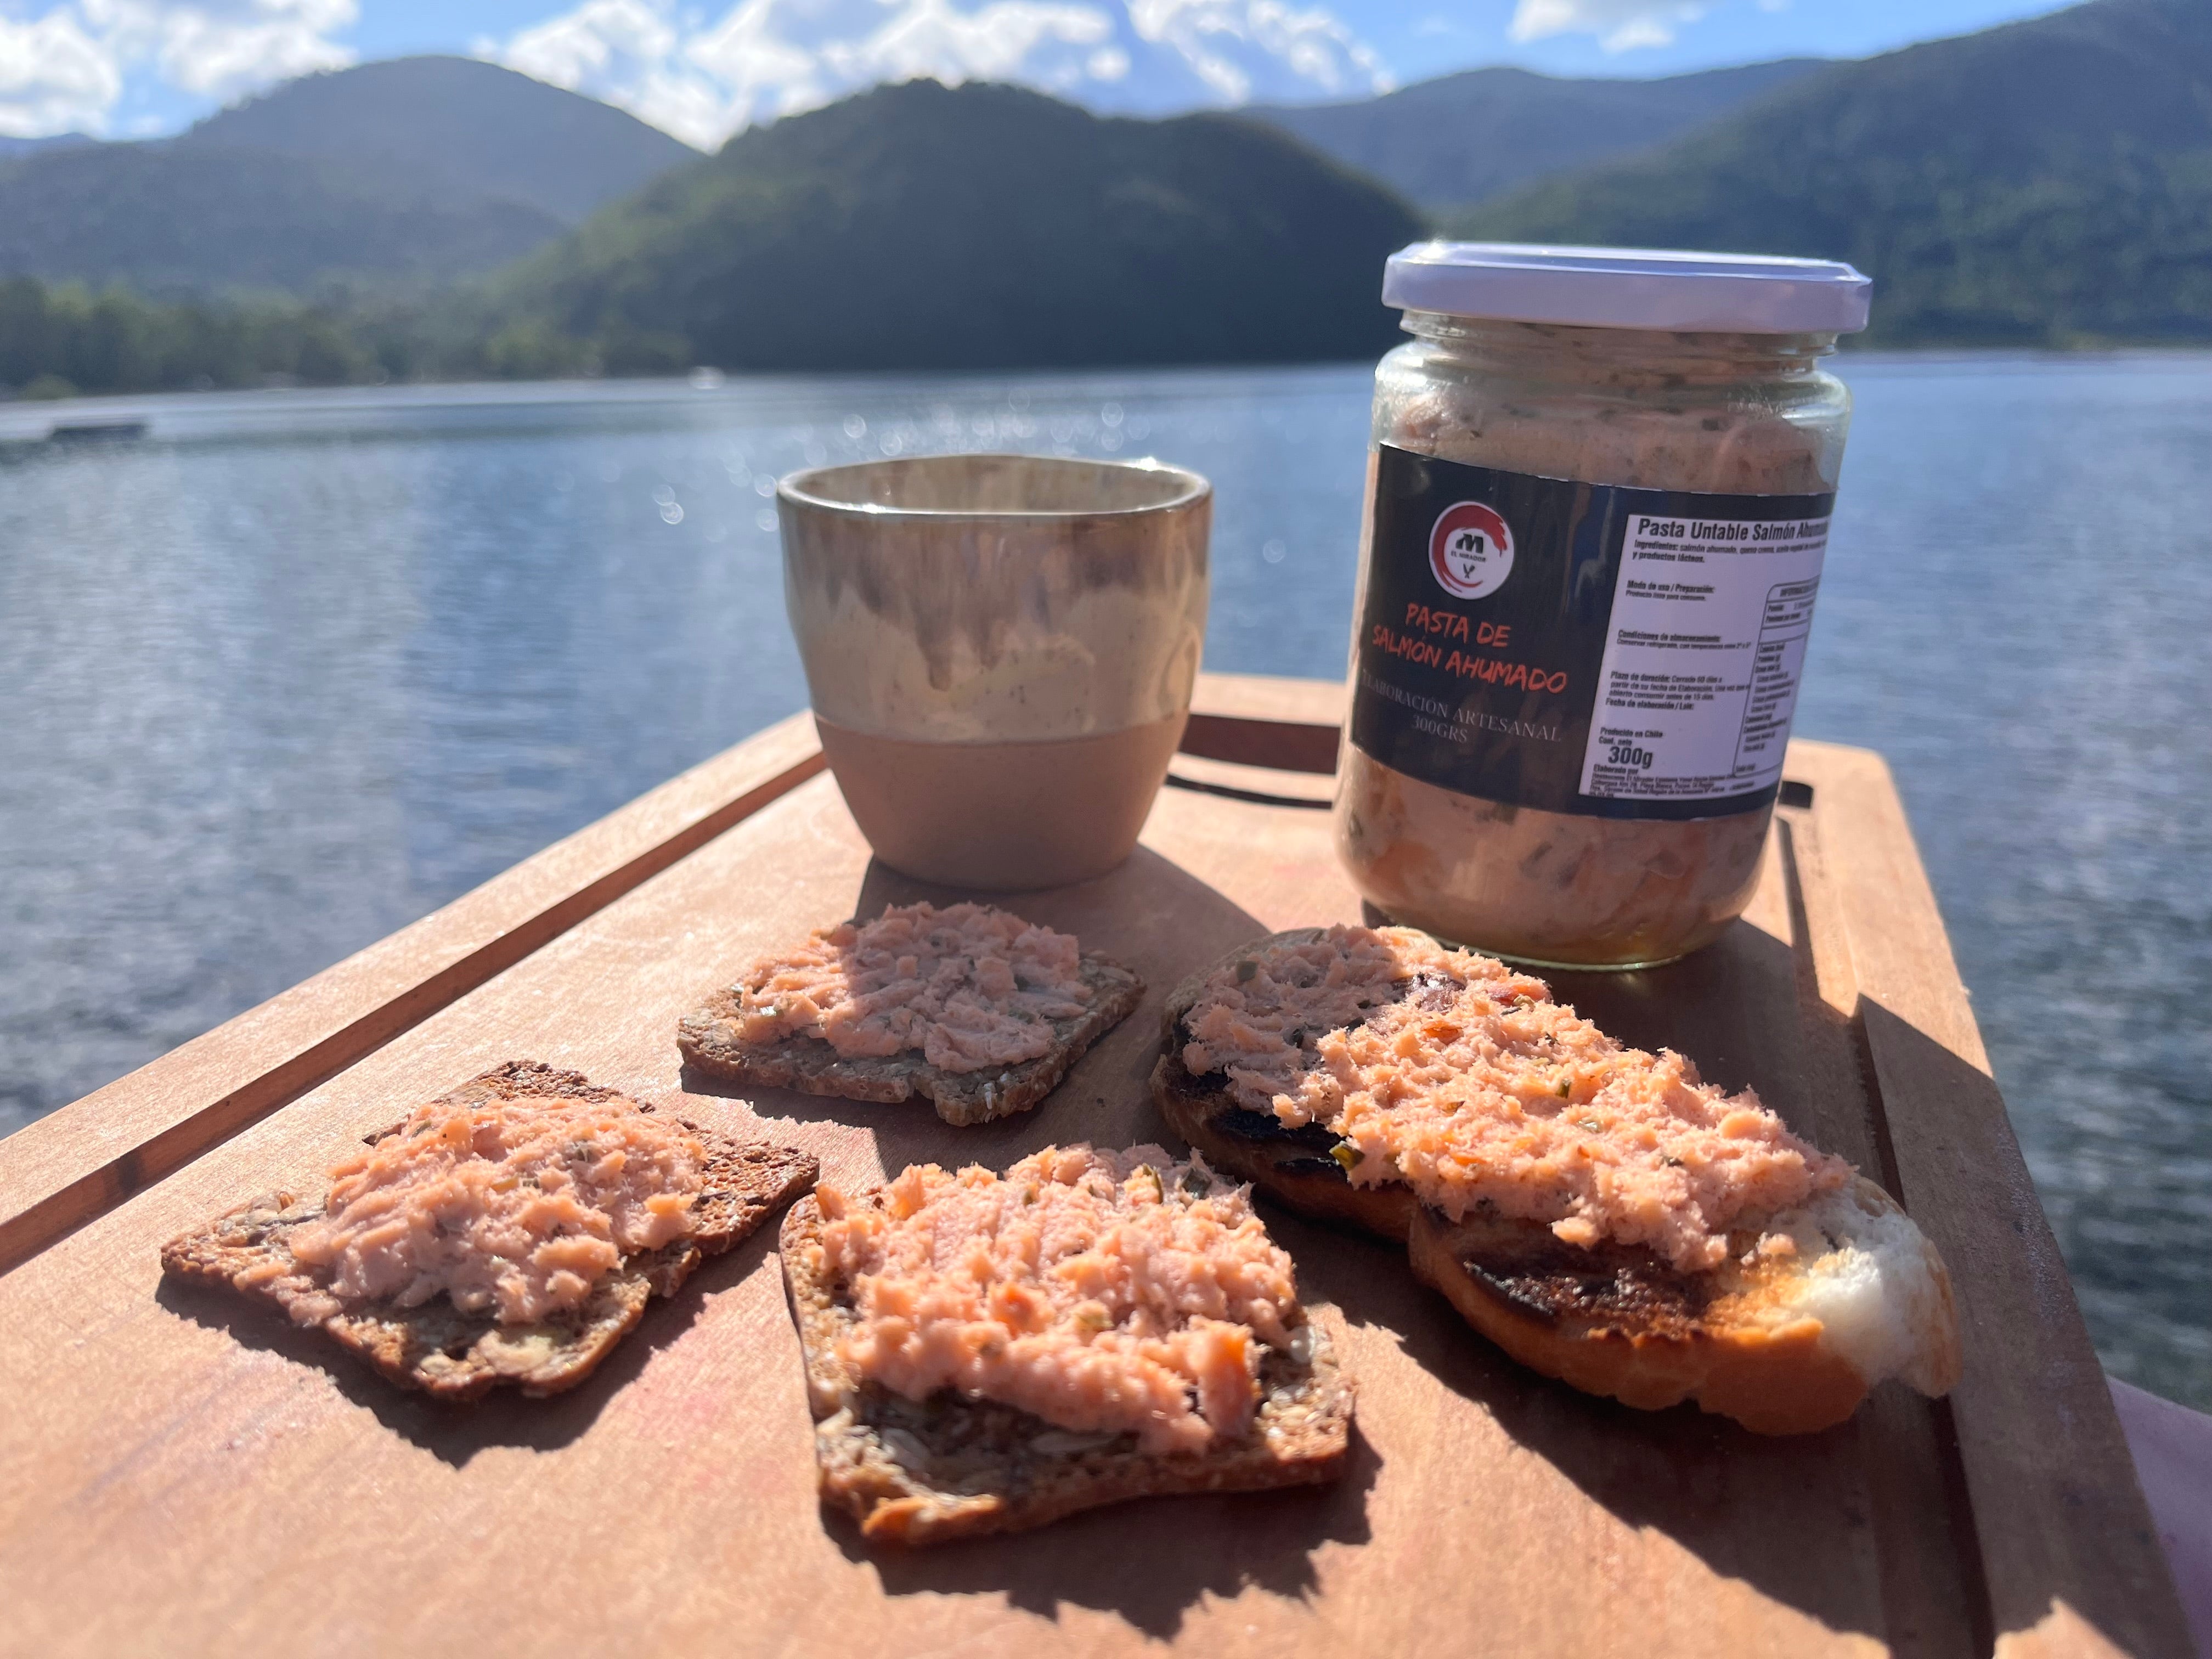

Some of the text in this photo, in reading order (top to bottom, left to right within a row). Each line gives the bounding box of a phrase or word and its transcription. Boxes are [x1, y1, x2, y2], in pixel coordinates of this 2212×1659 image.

[1638, 518, 1685, 538] Pasta
[1691, 522, 1748, 540] Untable
[1752, 522, 1795, 540] Salmón
[1459, 553, 1486, 562] MIRADOR
[1627, 580, 1646, 589] Modo
[1406, 603, 1511, 647] PASTA DE
[1373, 625, 1567, 693] SALMÓN AHUMADO
[1412, 715, 1468, 743] 300GRS
[1453, 708, 1561, 742] ARTESANAL
[1600, 727, 1633, 736] Producido
[1608, 746, 1652, 770] 300g
